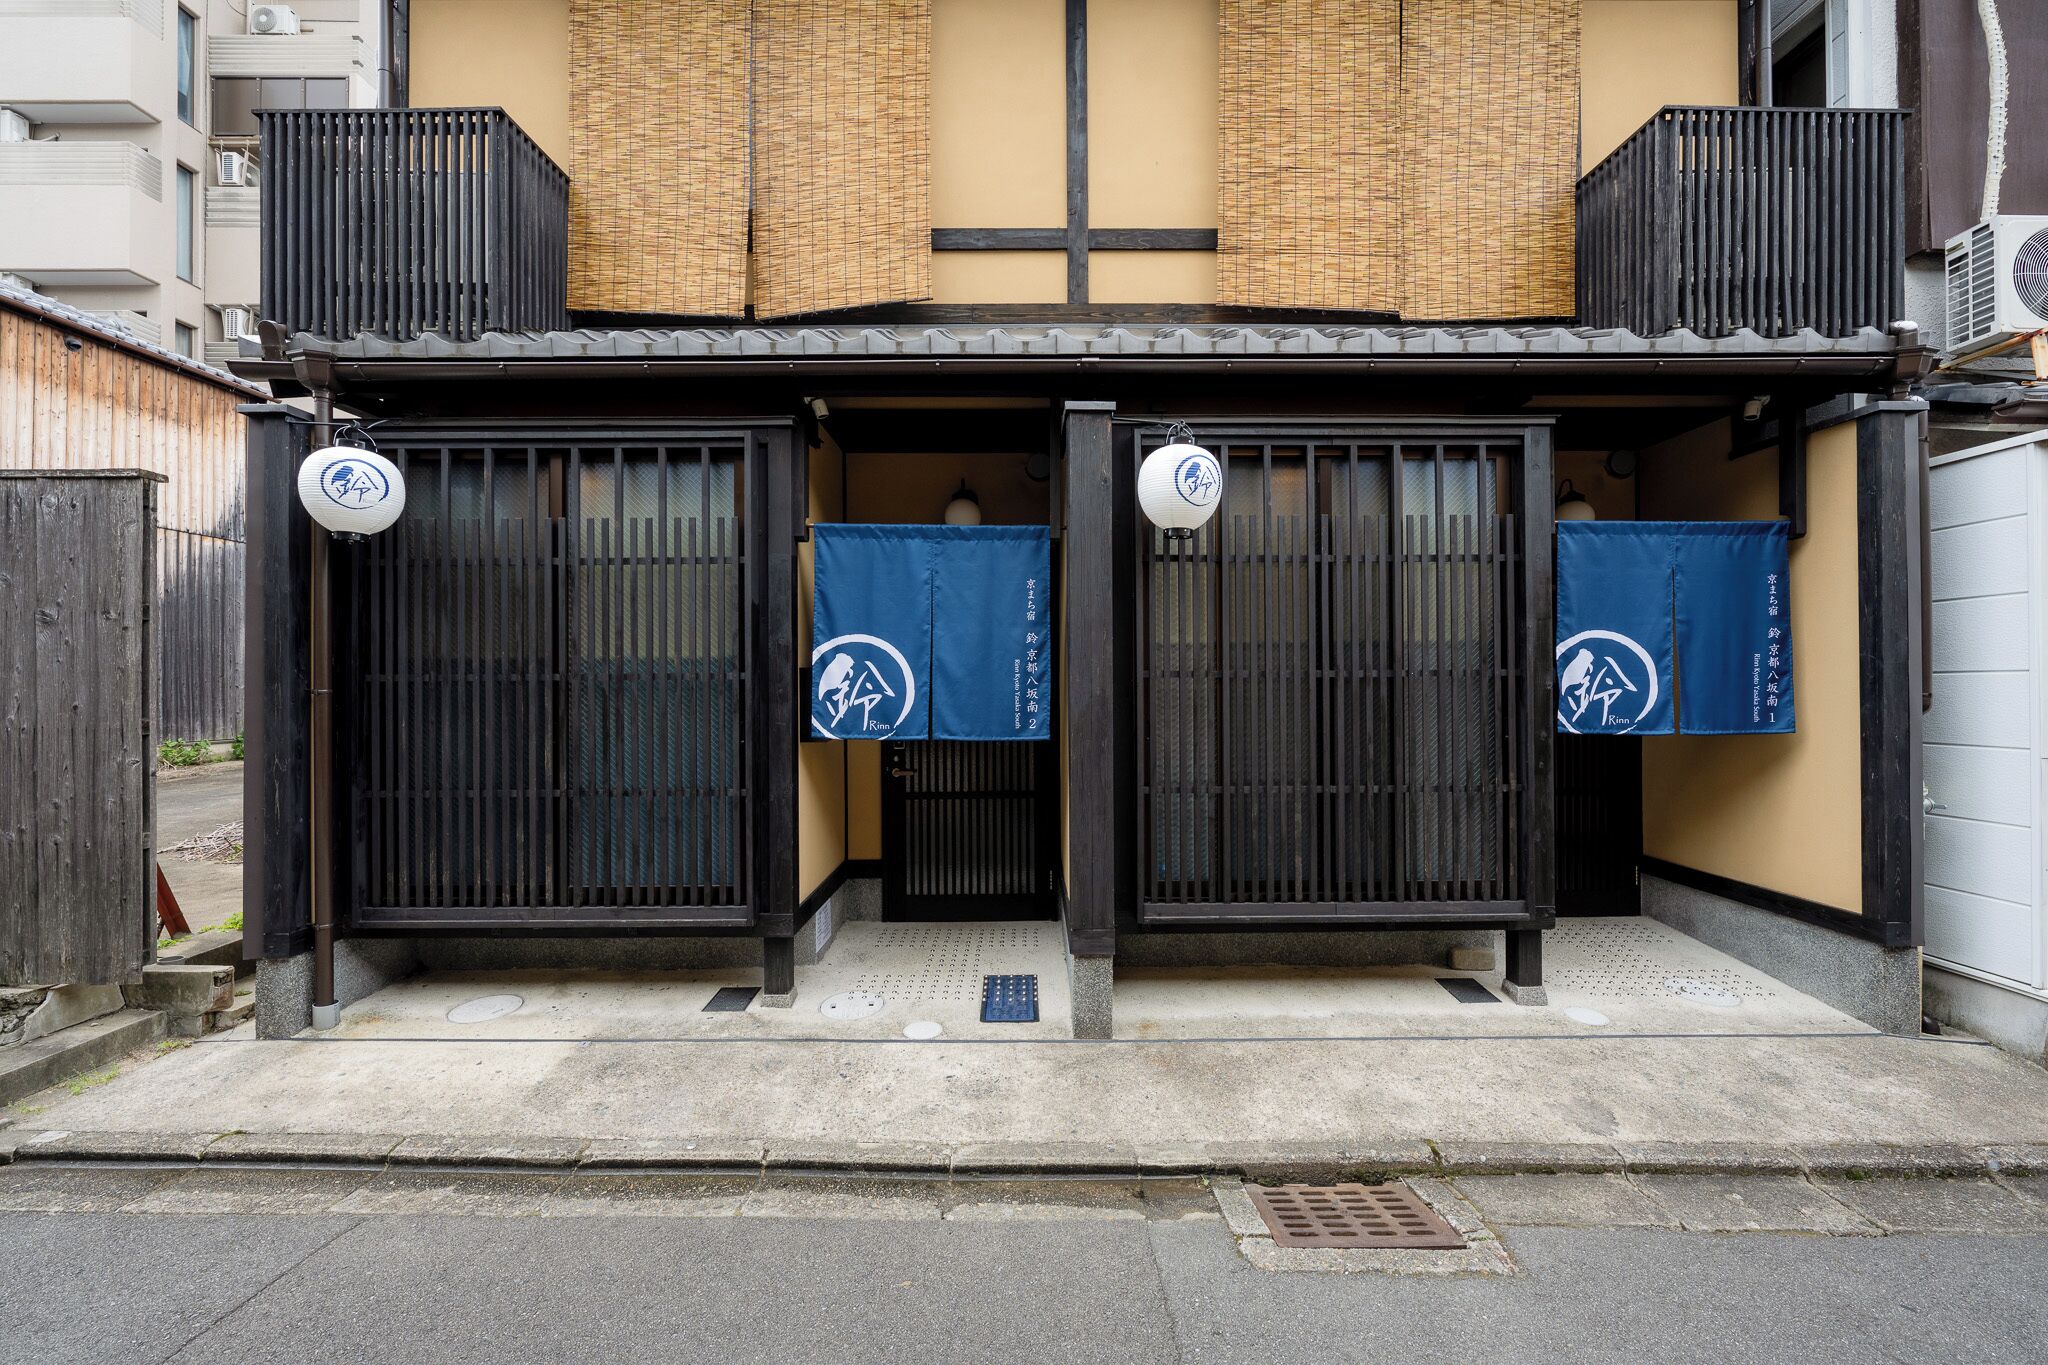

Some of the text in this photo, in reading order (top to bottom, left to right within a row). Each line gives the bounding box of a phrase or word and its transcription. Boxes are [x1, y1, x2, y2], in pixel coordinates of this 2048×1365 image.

[1026, 578, 1036, 620] 京まち宿
[1767, 574, 1778, 615] 京まち宿
[1013, 673, 1021, 691] Kyoto
[1752, 668, 1760, 685] Kyoto
[869, 720, 890, 730] Rinn
[1608, 714, 1630, 725] Rinn
